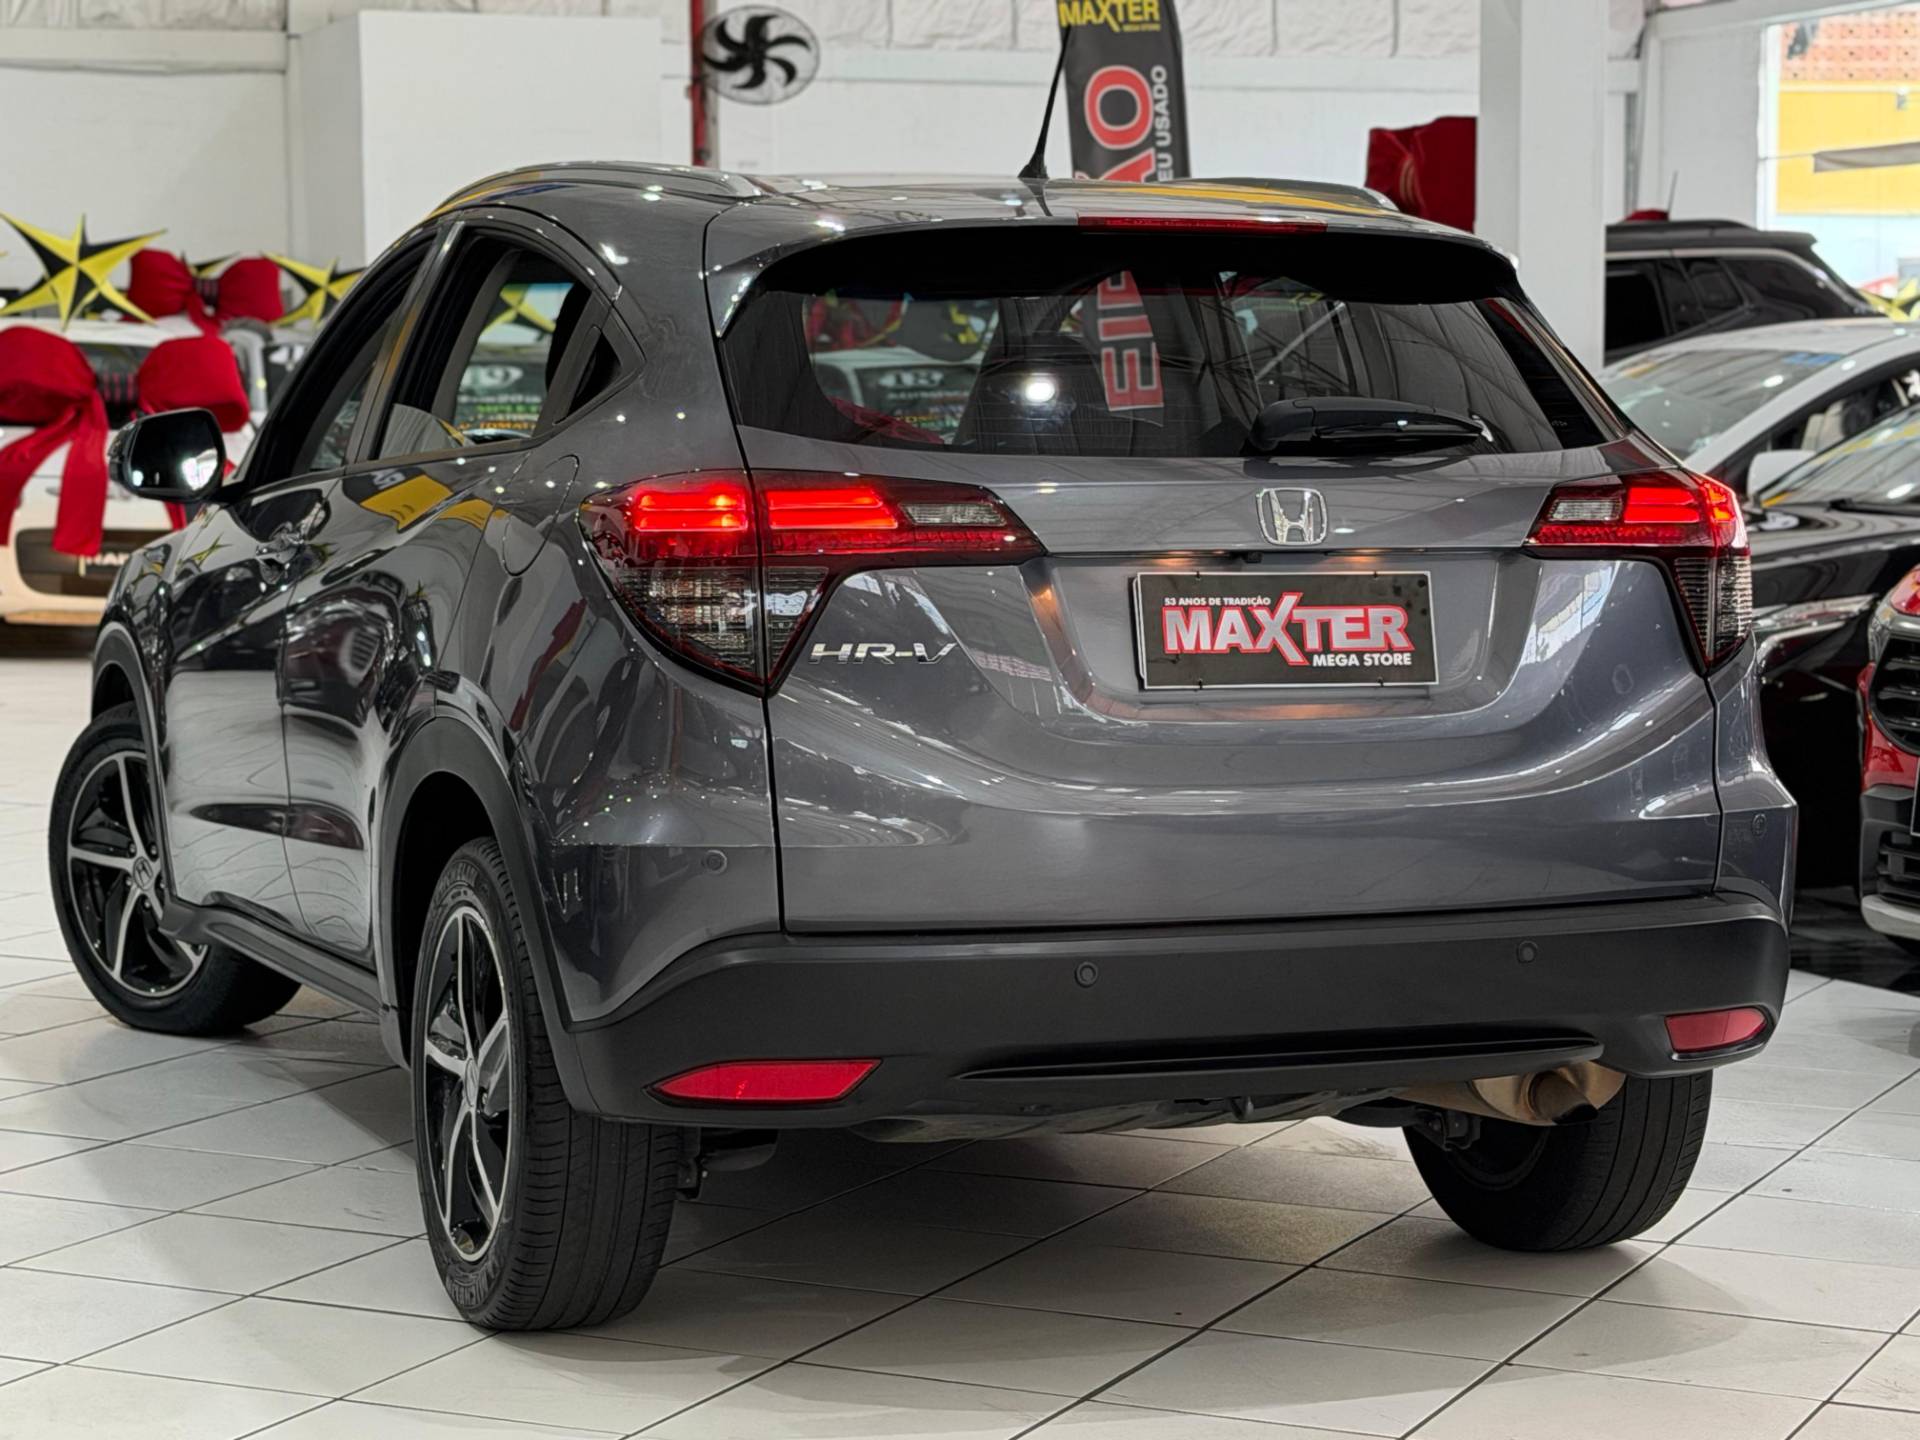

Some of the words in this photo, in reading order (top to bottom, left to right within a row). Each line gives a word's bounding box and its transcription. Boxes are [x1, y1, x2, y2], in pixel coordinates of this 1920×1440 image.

[1058, 0, 1161, 32] MAXTER
[1151, 65, 1172, 147] USADO
[1178, 597, 1207, 606] ANOS
[1208, 597, 1221, 606] DE
[1222, 595, 1271, 607] TRADIÇÃO
[1162, 592, 1415, 666] MAXTER
[808, 642, 957, 665] HR-V
[1312, 653, 1360, 667] MEGA
[1363, 652, 1412, 666] STORE
